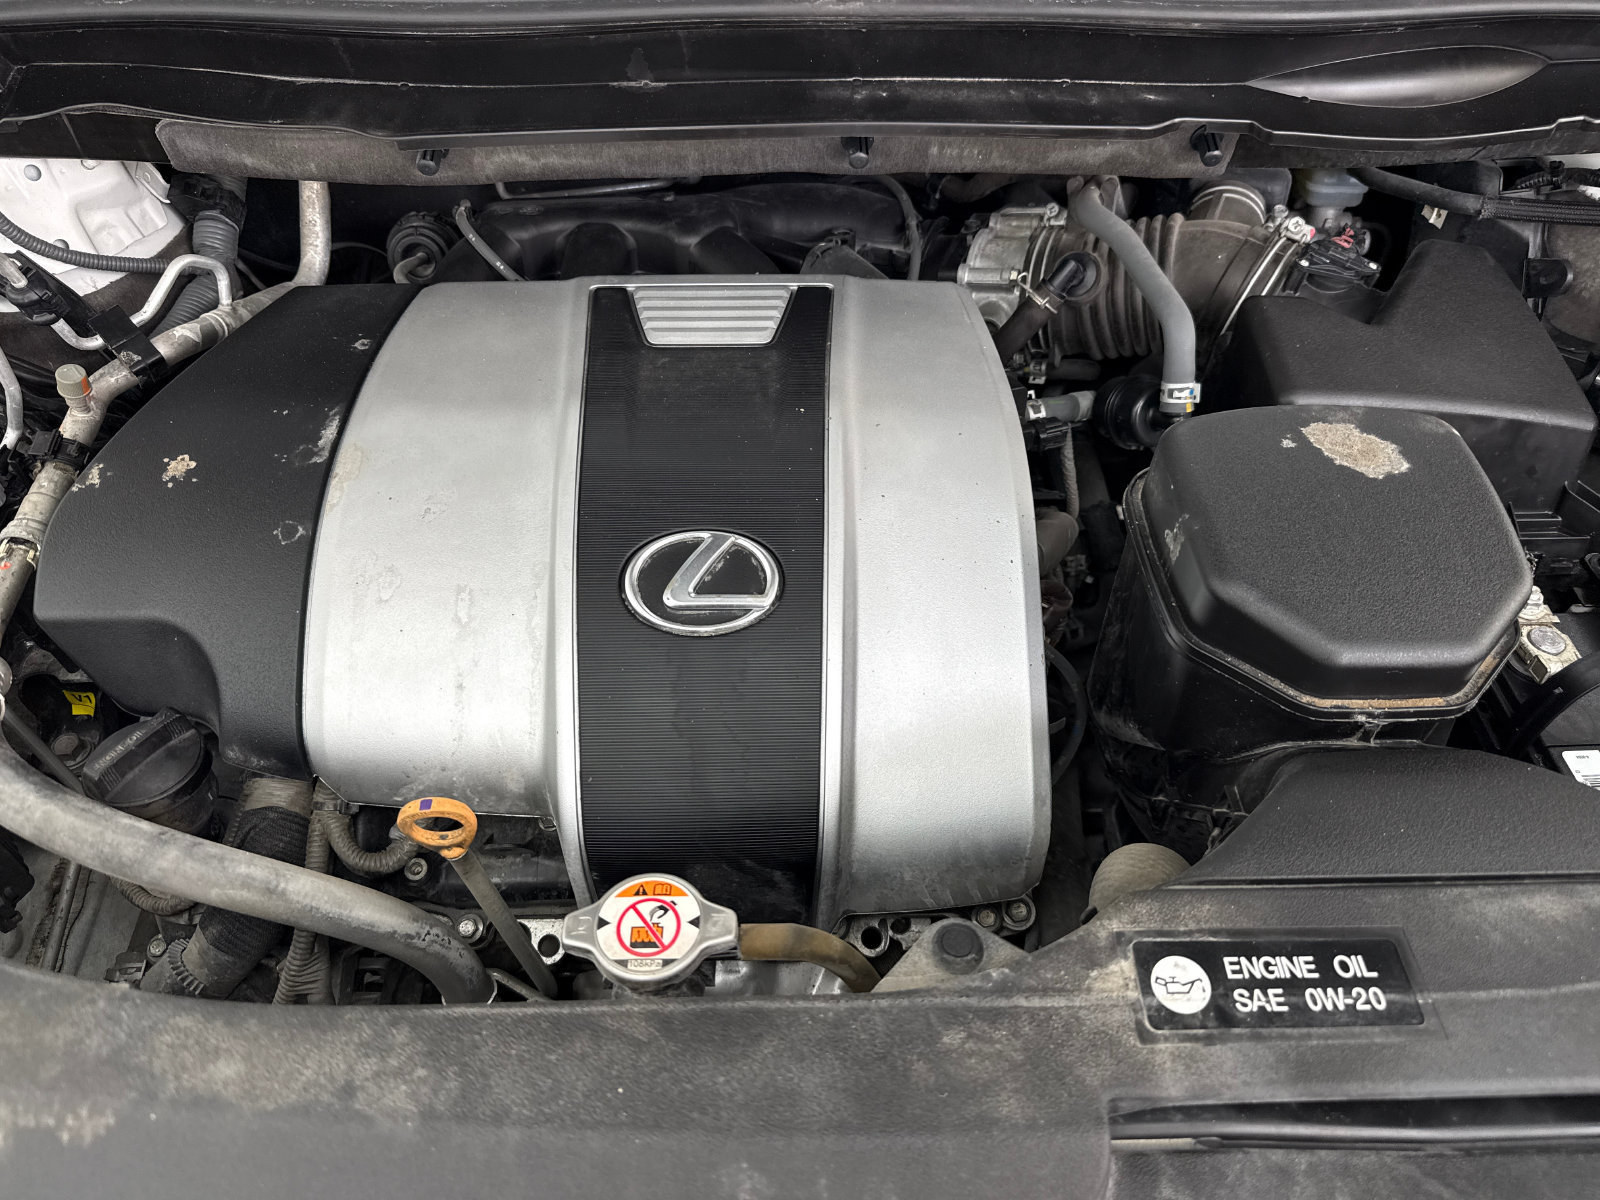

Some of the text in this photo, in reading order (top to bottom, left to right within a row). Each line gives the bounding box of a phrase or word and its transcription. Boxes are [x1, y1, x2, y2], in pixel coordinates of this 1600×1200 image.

[1223, 954, 1379, 979] ENGINE OIL
[1233, 986, 1387, 1012] SAE 0W-20
